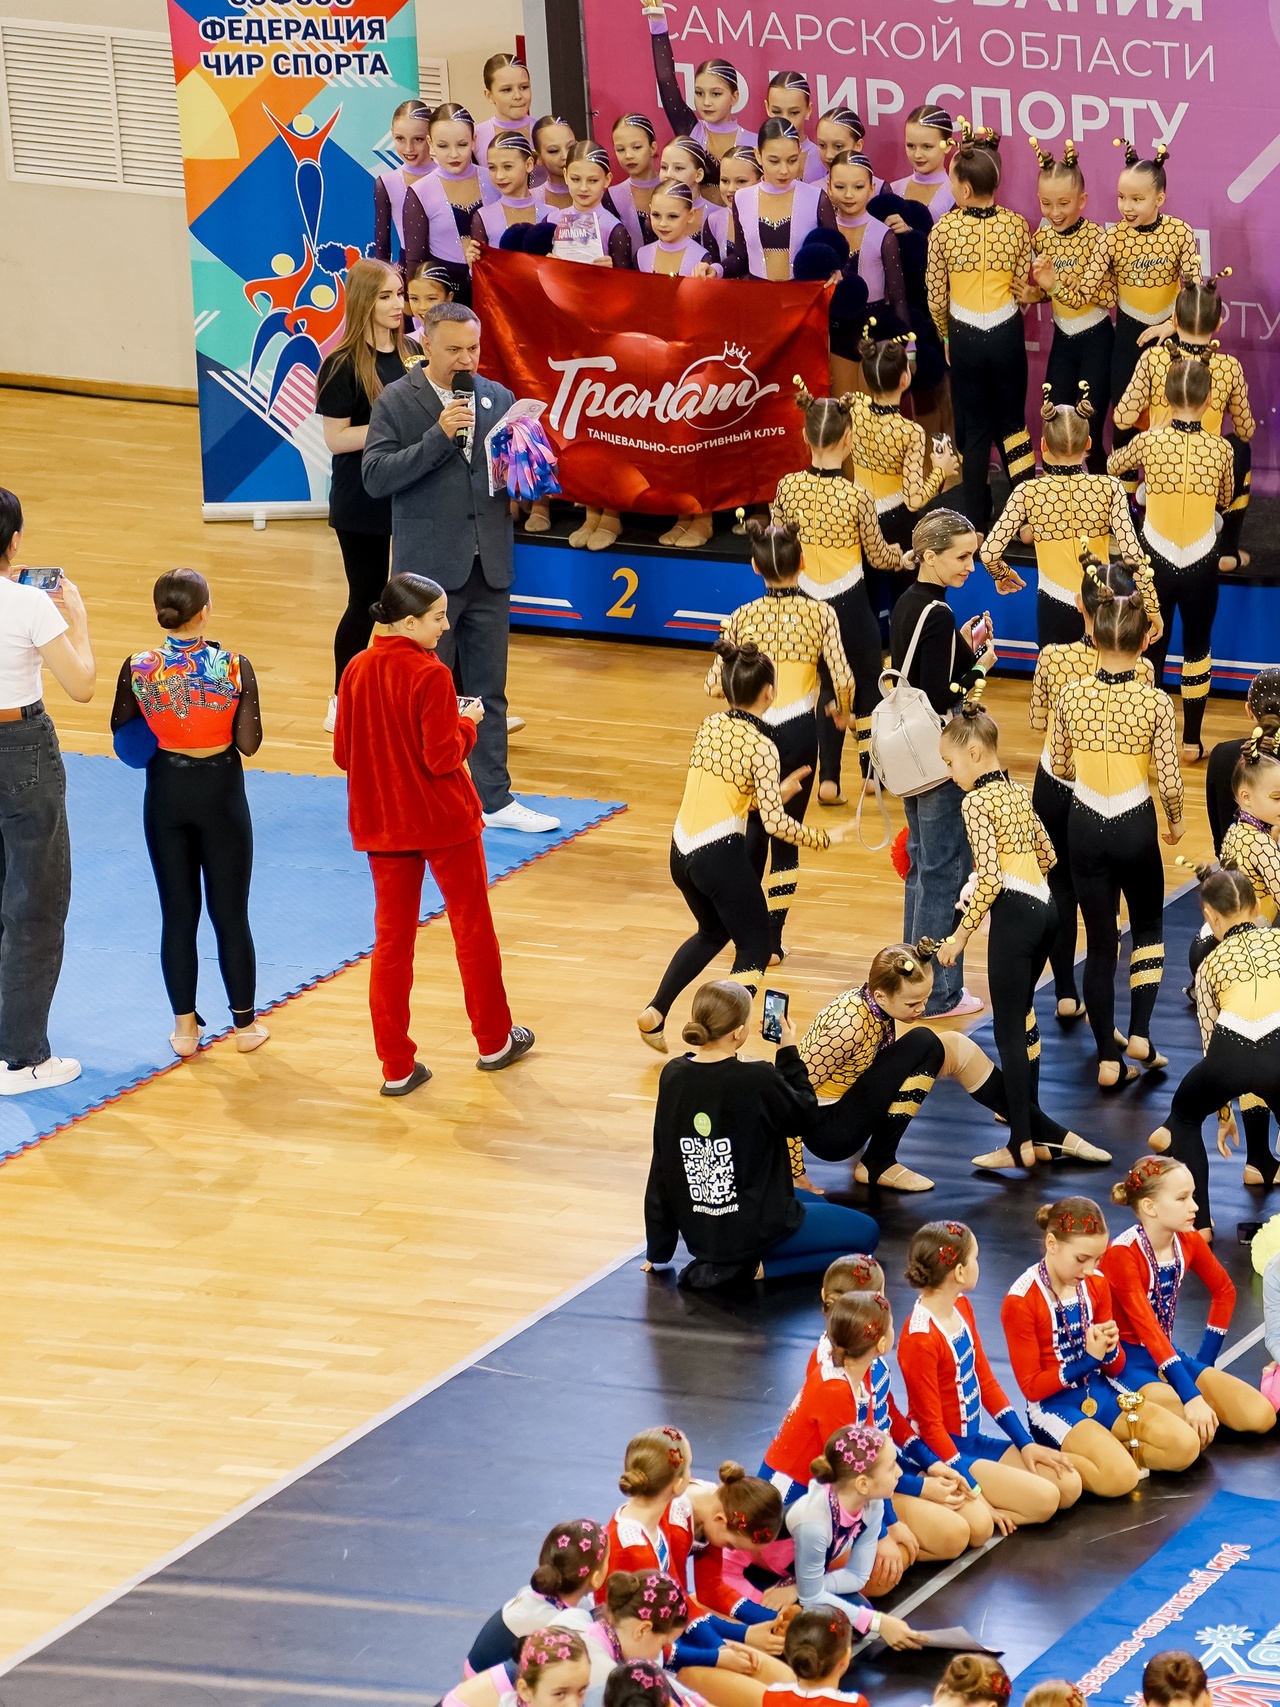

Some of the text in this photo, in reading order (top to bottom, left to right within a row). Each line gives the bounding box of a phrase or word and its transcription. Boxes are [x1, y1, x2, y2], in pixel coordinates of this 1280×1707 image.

[200, 17, 387, 45] ФЕДЕРАЦИЯ
[201, 52, 391, 77] ЧИР СПОРТА
[979, 28, 1215, 82] ОБЛАСТИ
[768, 70, 905, 126] ИР
[925, 83, 1190, 149] СПОРТУ
[587, 426, 786, 454] ТАНЦЕВАЛЬНО-СПОРТИВНЫЙ КЛУБ
[606, 567, 639, 619] 2
